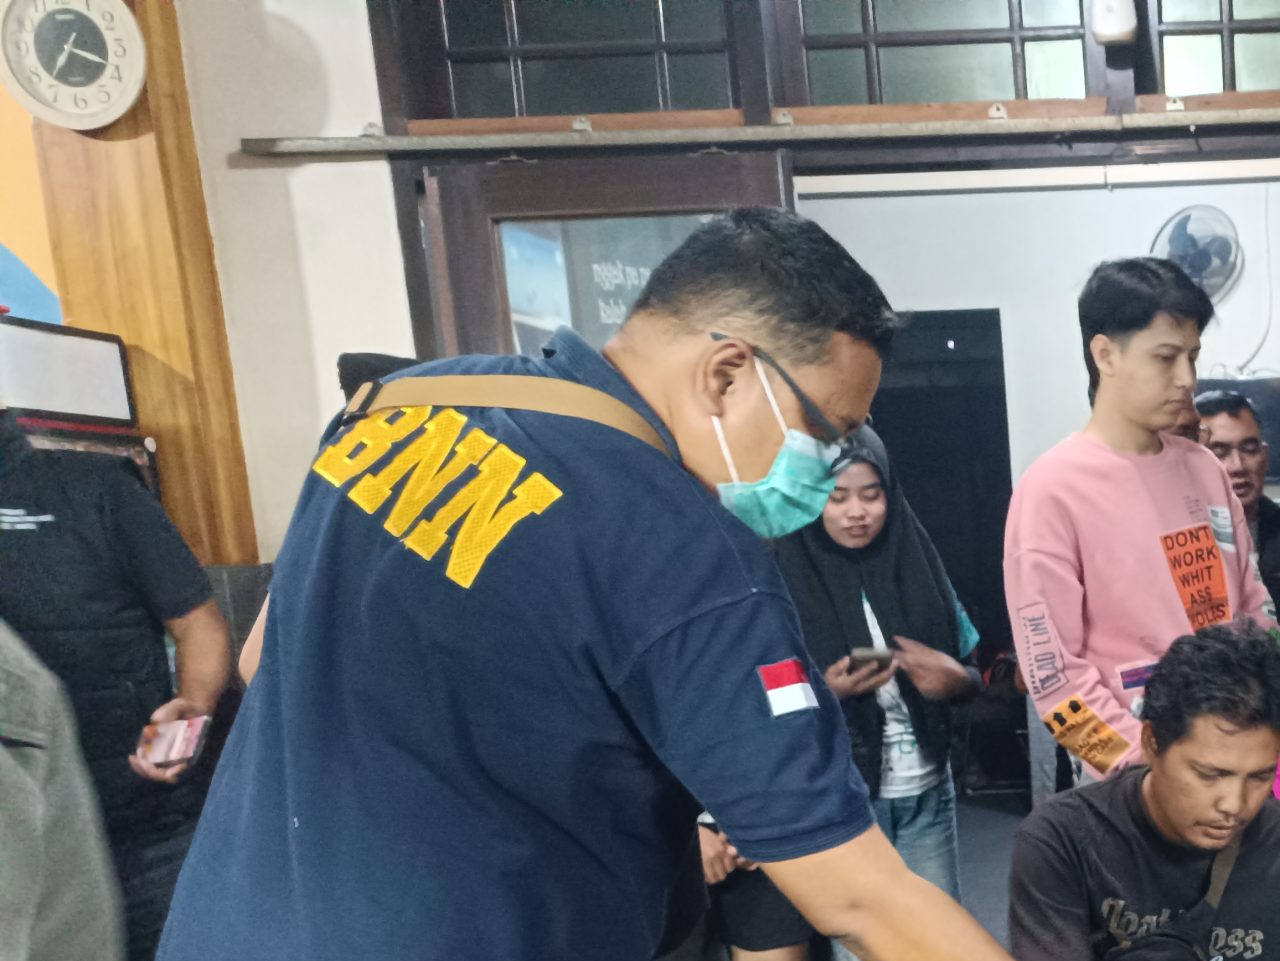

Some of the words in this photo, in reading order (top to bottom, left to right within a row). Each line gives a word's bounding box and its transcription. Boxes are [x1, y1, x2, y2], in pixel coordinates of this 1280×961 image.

[101, 10, 116, 31] 2
[15, 39, 30, 58] 9
[113, 38, 127, 59] 3
[108, 64, 123, 84] 4
[47, 83, 60, 104] 7
[73, 92, 89, 110] 6
[97, 84, 112, 105] 5
[312, 404, 564, 589] BNN
[1169, 545, 1217, 571] WORK
[1178, 566, 1214, 589] WHIT
[1189, 586, 1213, 606] ASS
[1028, 612, 1052, 647] LINE
